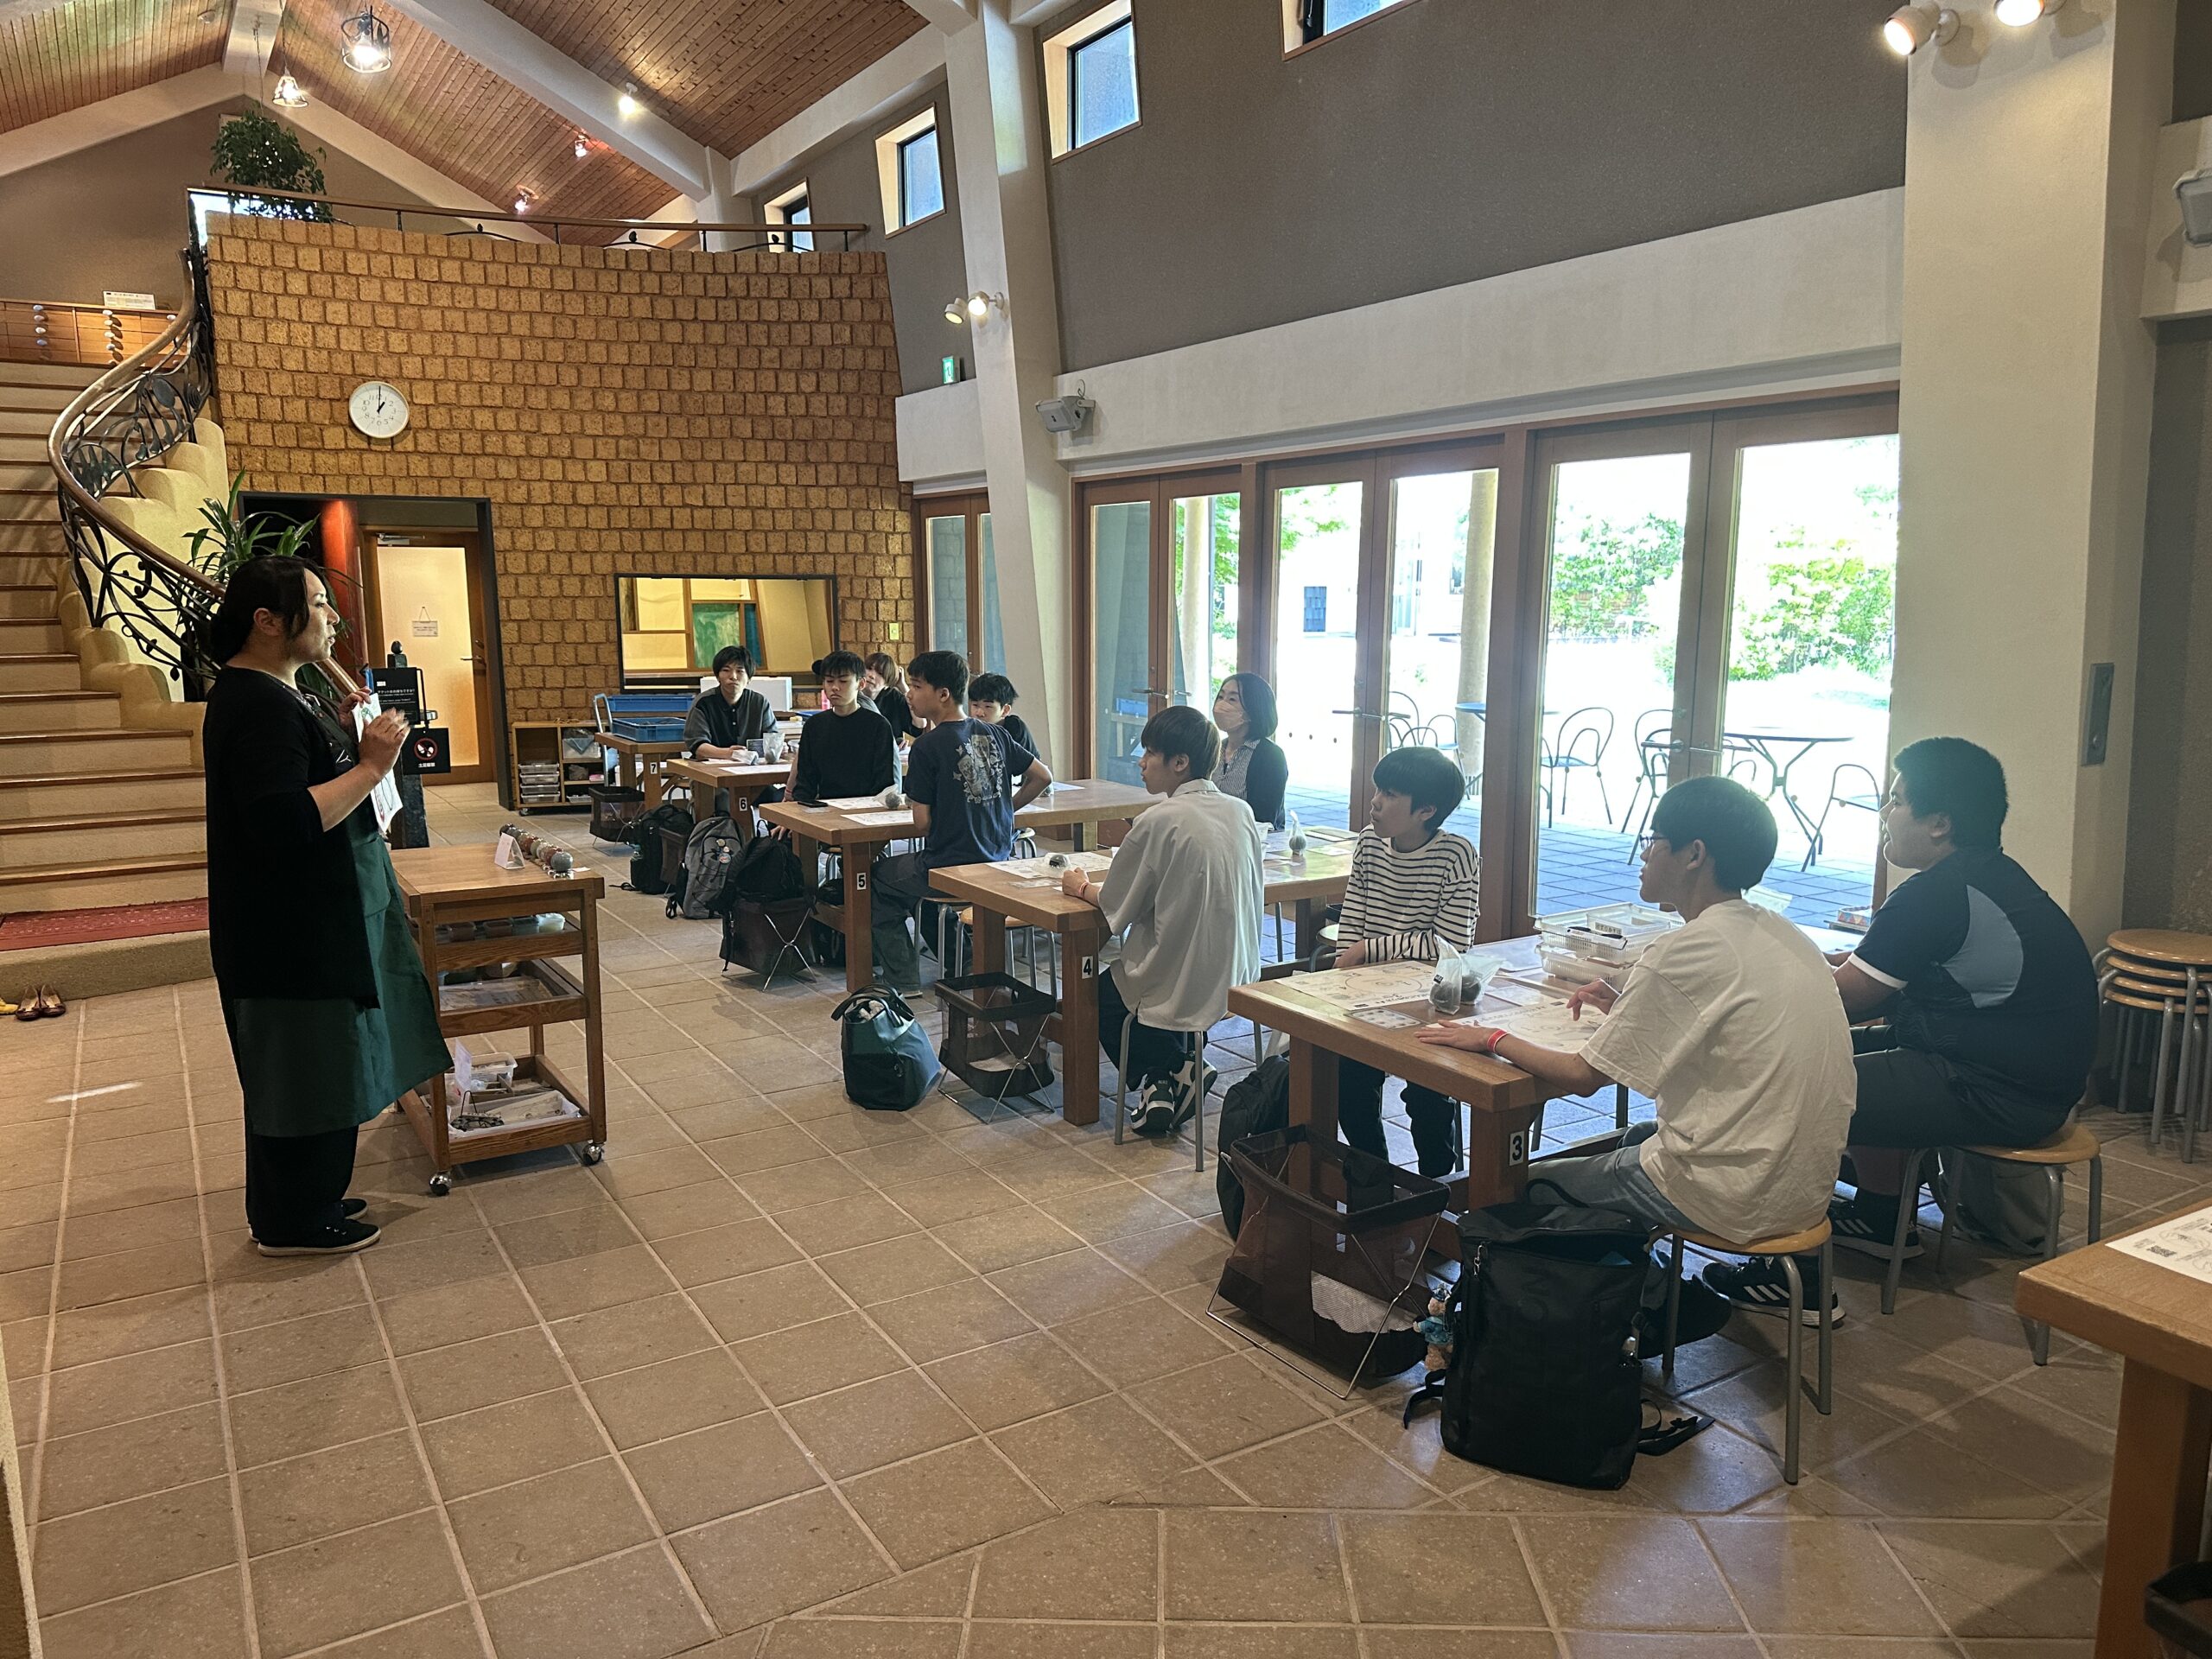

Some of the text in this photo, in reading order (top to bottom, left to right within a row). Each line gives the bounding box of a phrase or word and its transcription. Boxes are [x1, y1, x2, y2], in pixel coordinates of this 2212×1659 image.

[651, 763, 657, 773] 7
[741, 798, 747, 810] 6
[858, 874, 866, 888] 5
[1083, 958, 1092, 976] 4
[1512, 1135, 1522, 1161] 3
